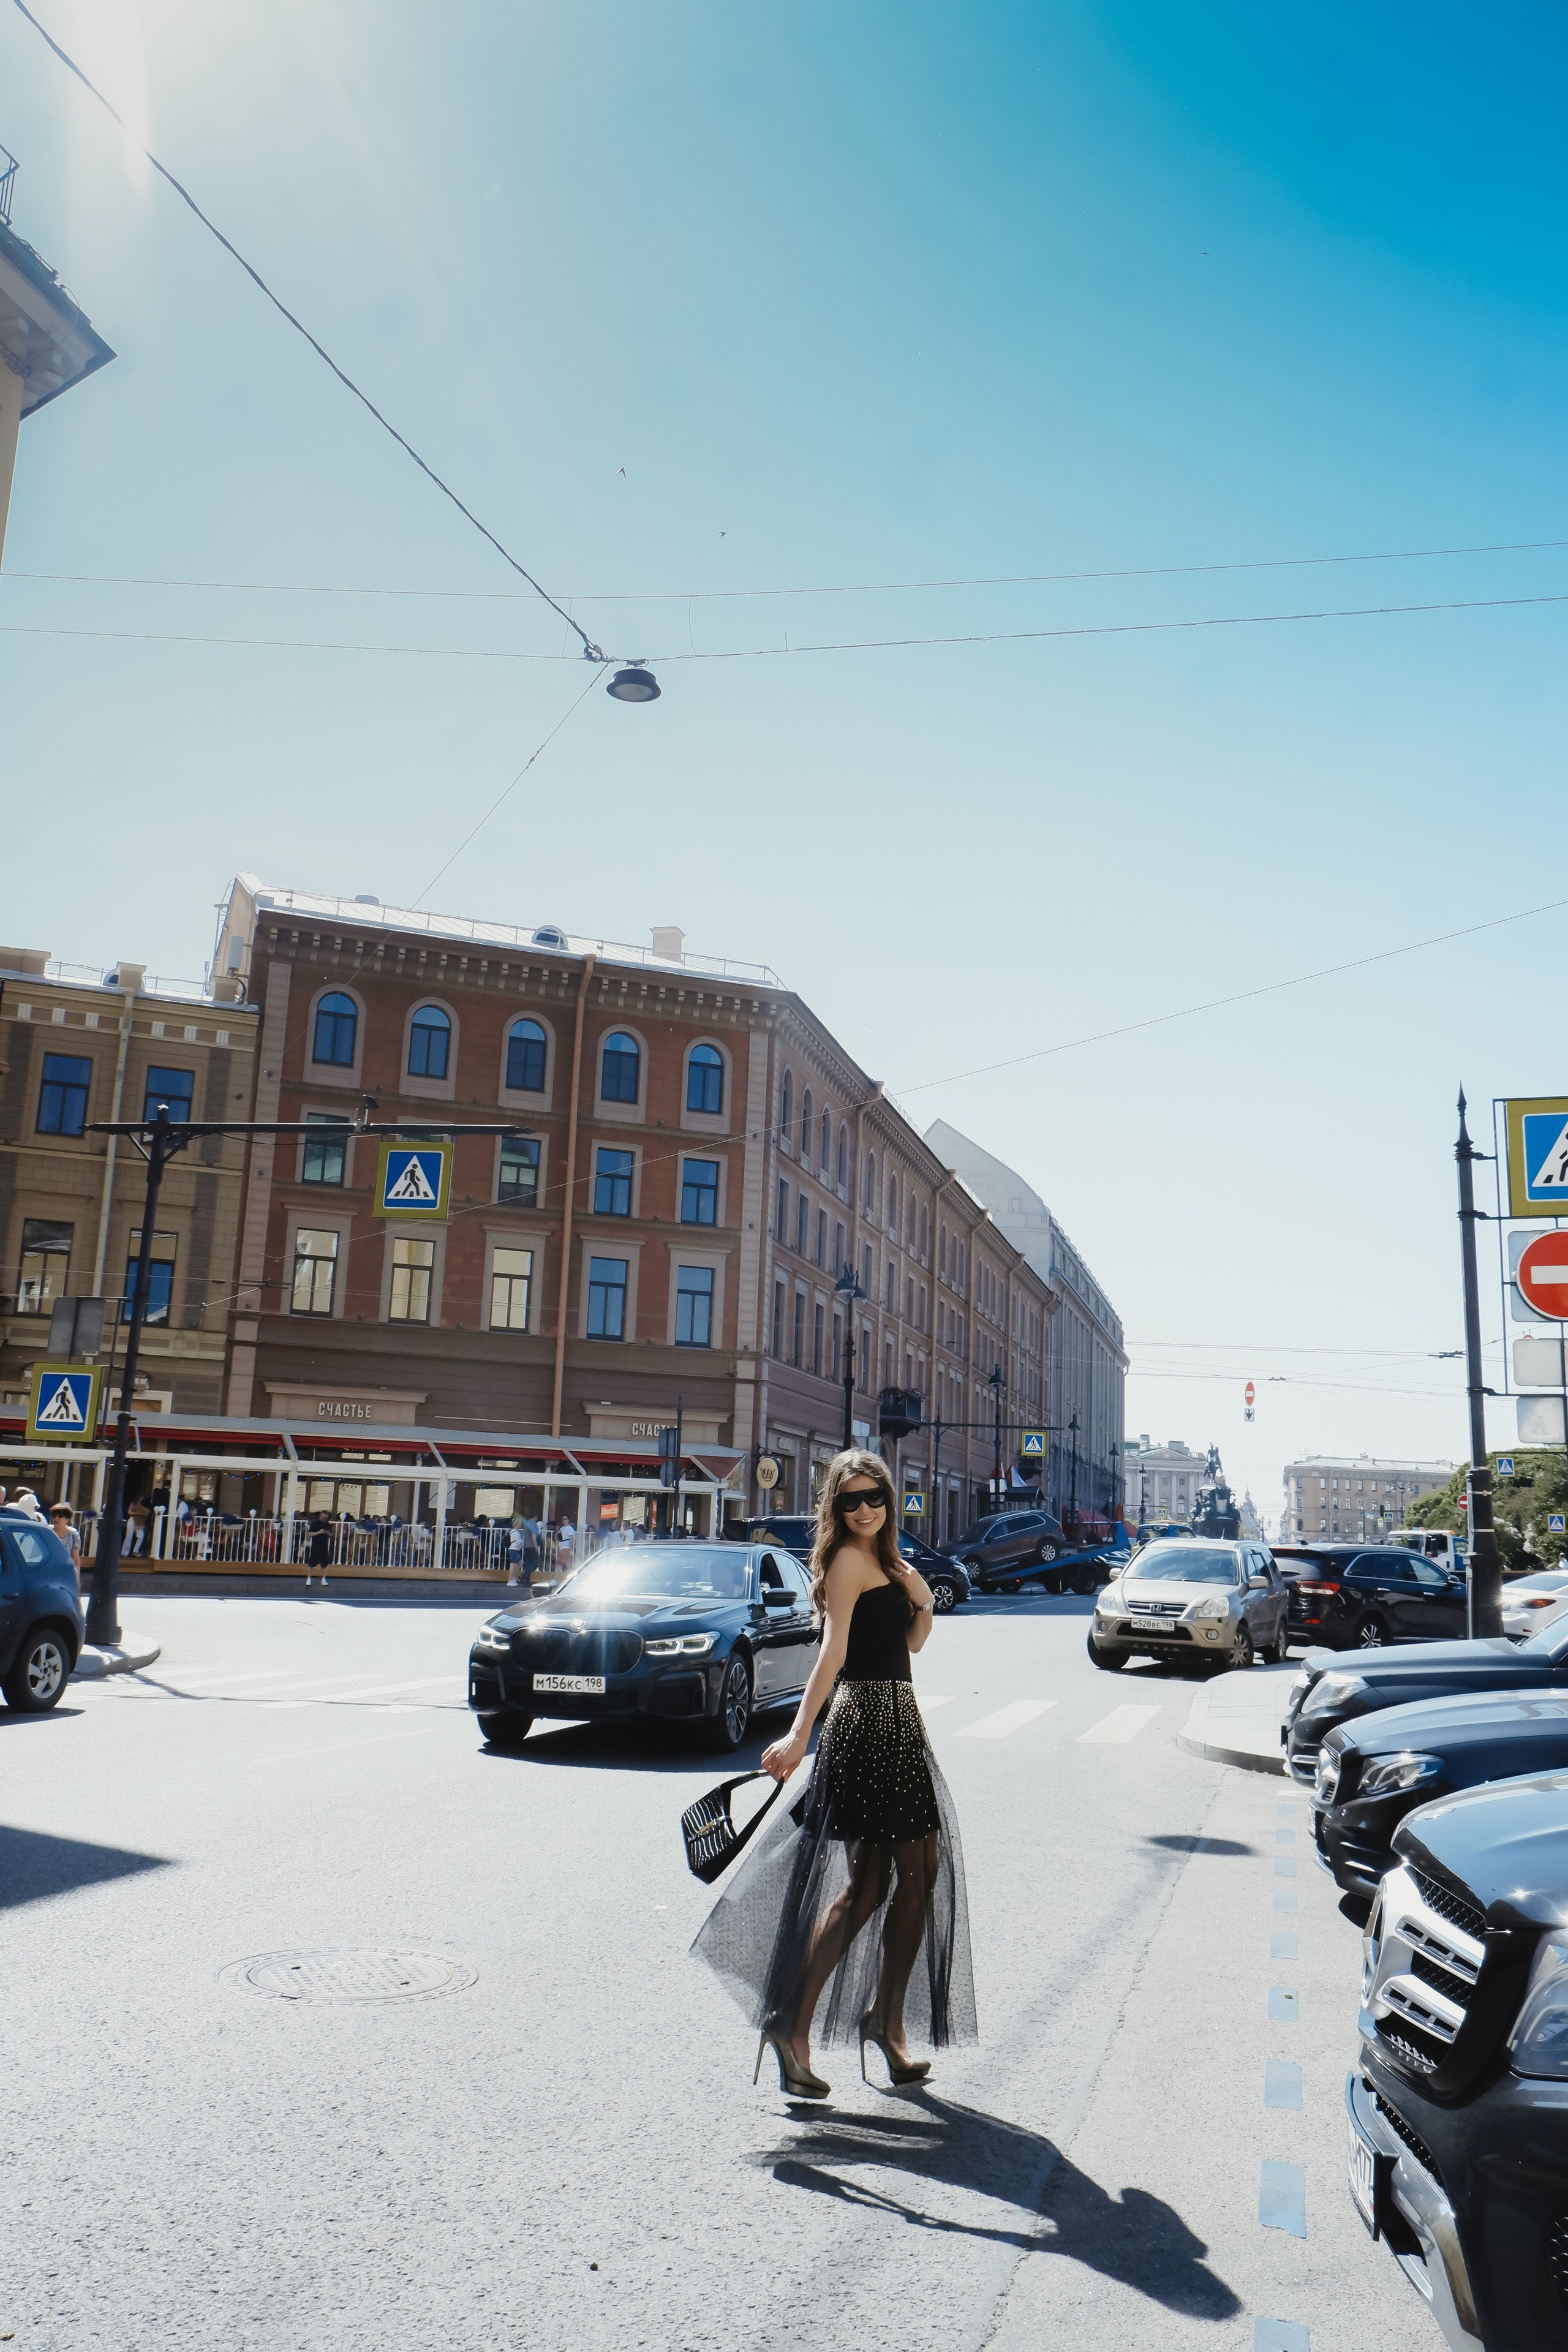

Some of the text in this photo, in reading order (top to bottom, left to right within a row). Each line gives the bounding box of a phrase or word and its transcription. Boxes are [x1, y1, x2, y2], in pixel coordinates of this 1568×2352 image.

[318, 1402, 372, 1418] СЧАСТЬЕ
[632, 1423, 677, 1437] СЧАС
[536, 1676, 602, 1690] М156КС 198
